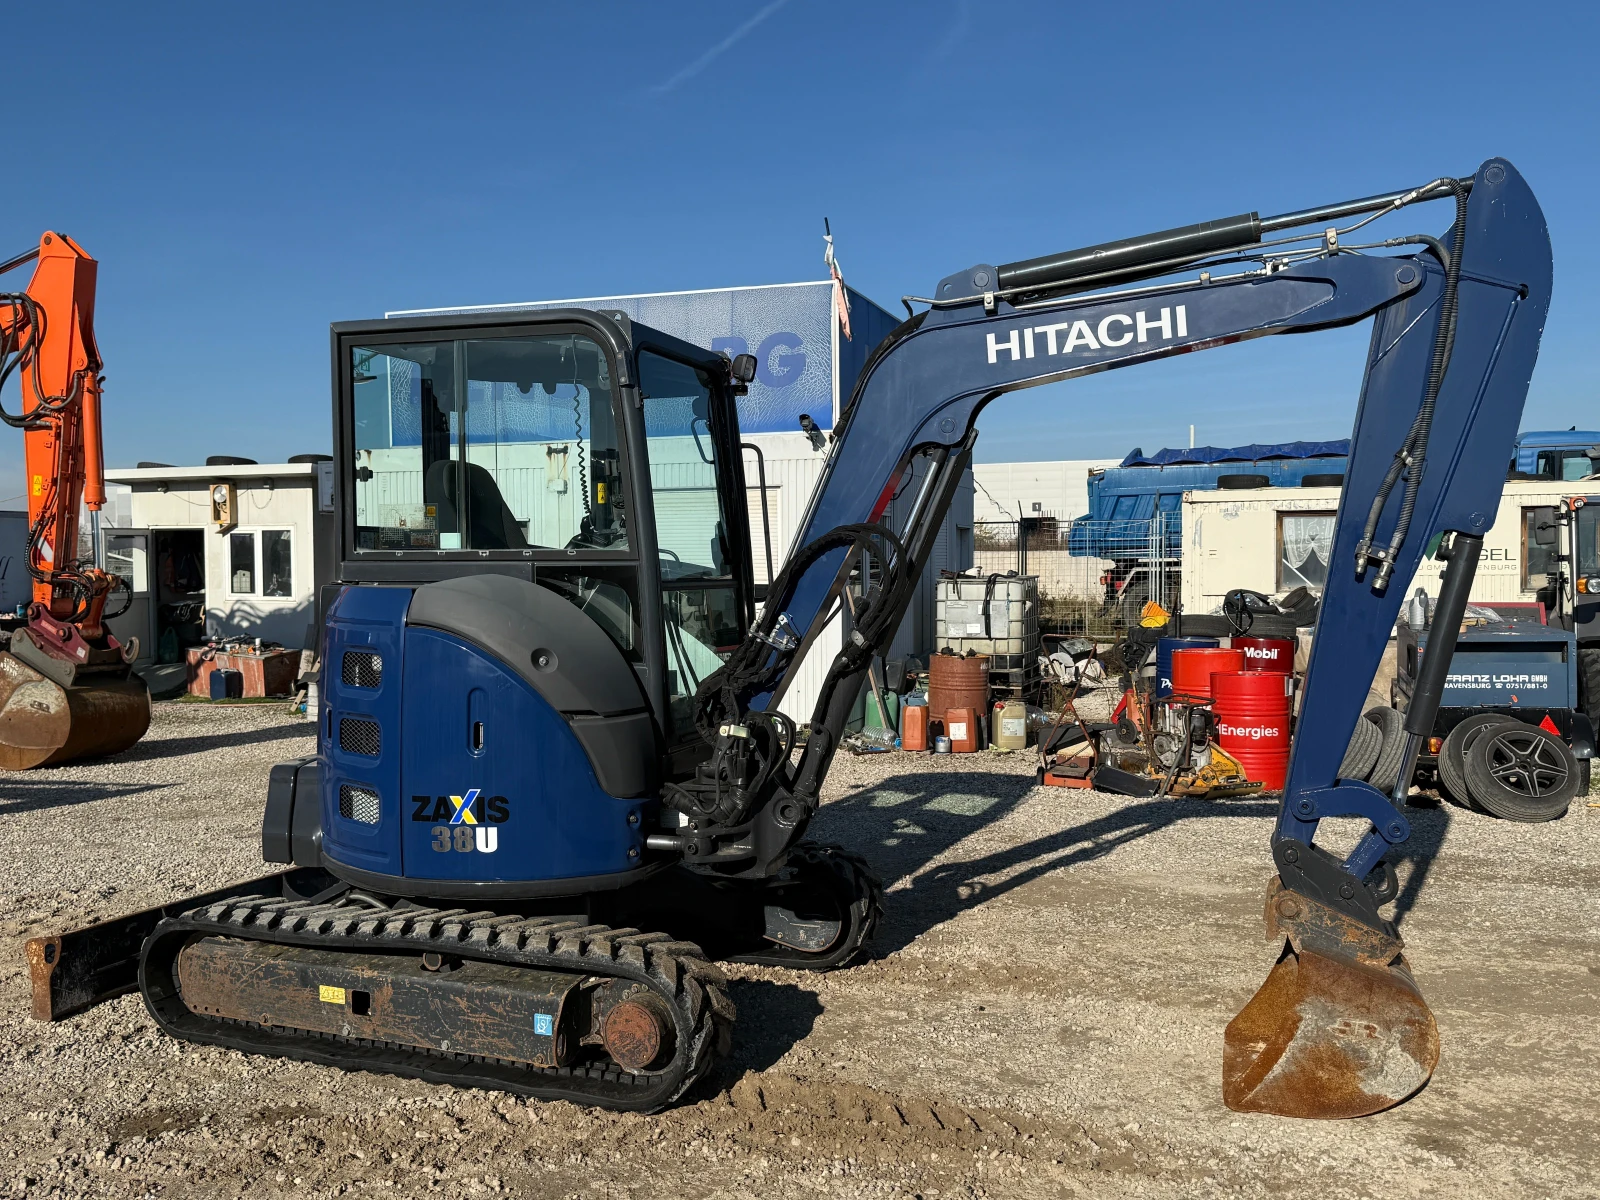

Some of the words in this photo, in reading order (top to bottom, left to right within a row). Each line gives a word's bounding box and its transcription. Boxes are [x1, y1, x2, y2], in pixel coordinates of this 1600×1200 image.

[986, 305, 1188, 364] HITACHI
[1244, 647, 1278, 660] Mobil
[1446, 674, 1490, 683] FRANZ
[1493, 674, 1529, 683] LOHR
[1531, 674, 1548, 683] GMBH
[411, 789, 509, 824] ZAXIS
[431, 826, 498, 853] 38U
